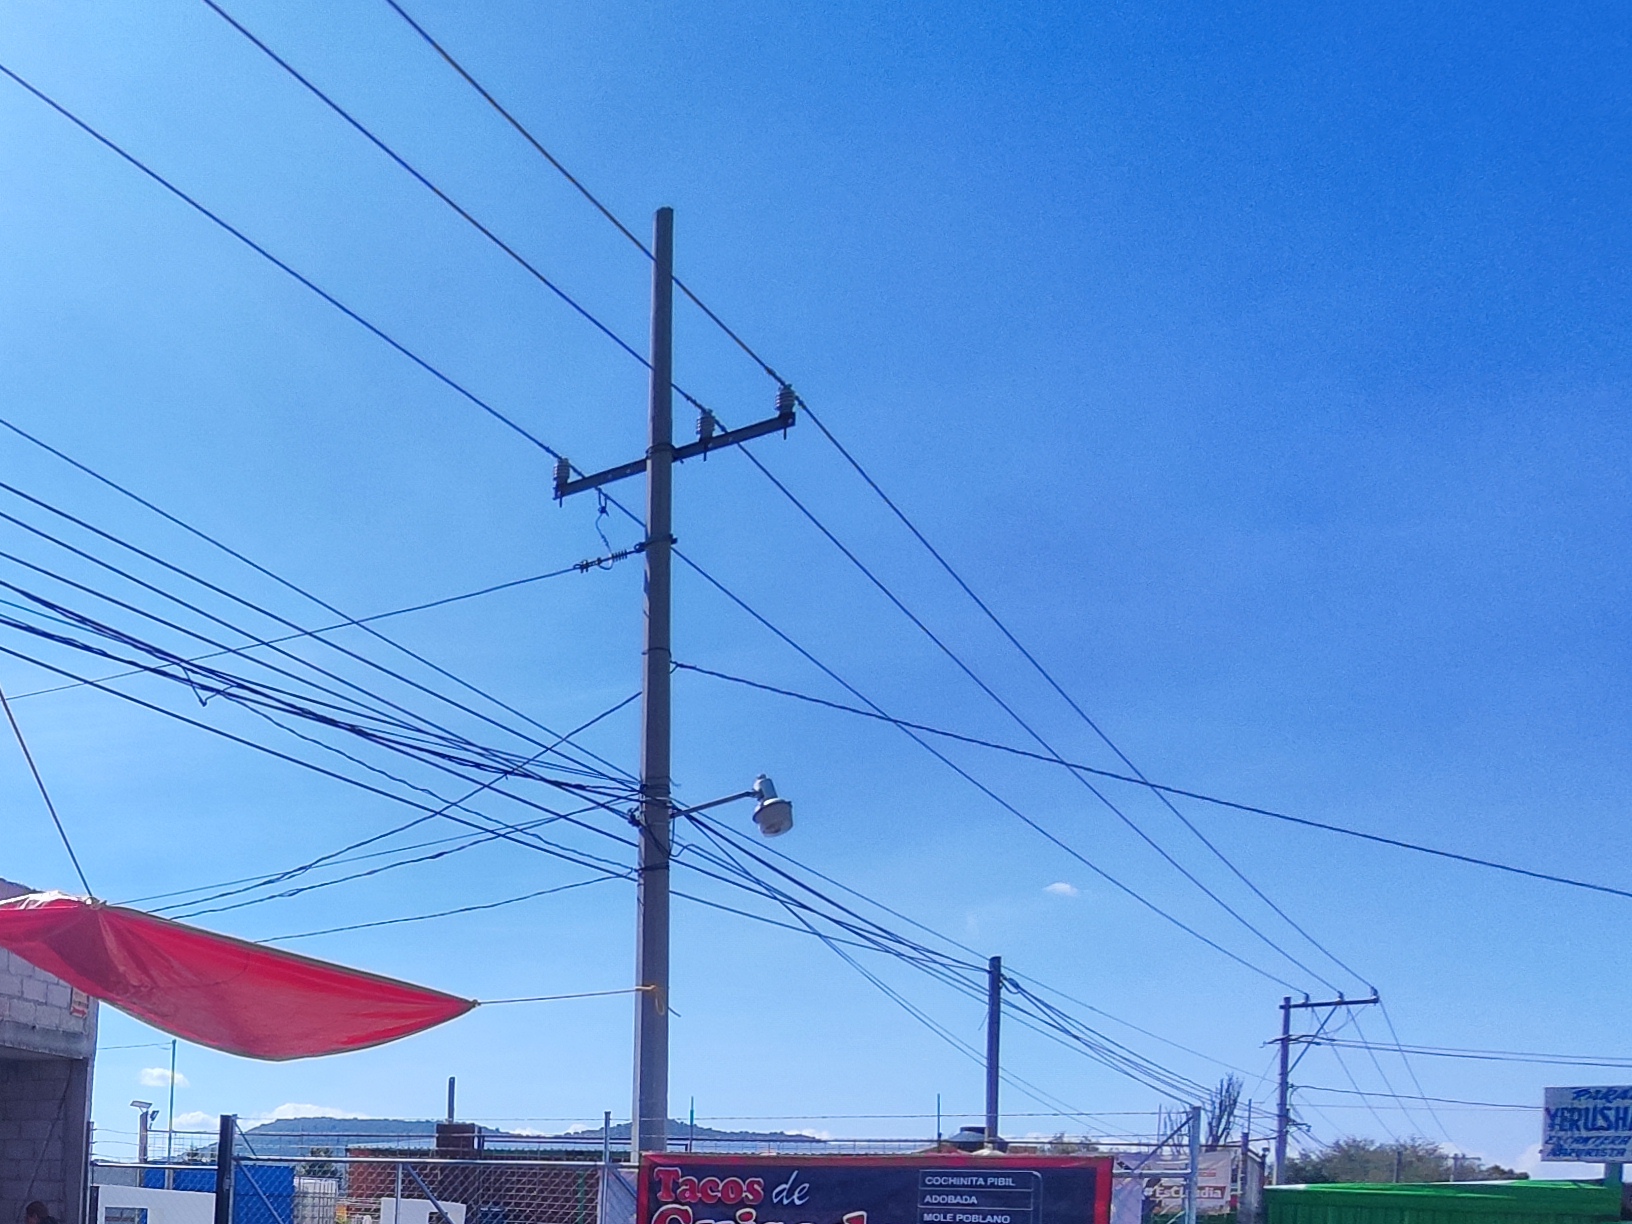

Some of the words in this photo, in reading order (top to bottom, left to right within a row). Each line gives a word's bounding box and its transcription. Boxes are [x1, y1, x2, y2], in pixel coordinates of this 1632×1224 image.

[1545, 1106, 1632, 1132] YERUSH
[653, 1167, 765, 1205] Tacos
[772, 1170, 810, 1206] de
[925, 1176, 985, 1186] COCHINITA
[987, 1177, 1016, 1187] PIBIL
[924, 1195, 978, 1204] ADOBADA
[923, 1213, 954, 1222] MOLE
[956, 1214, 1010, 1224] POBLANO
